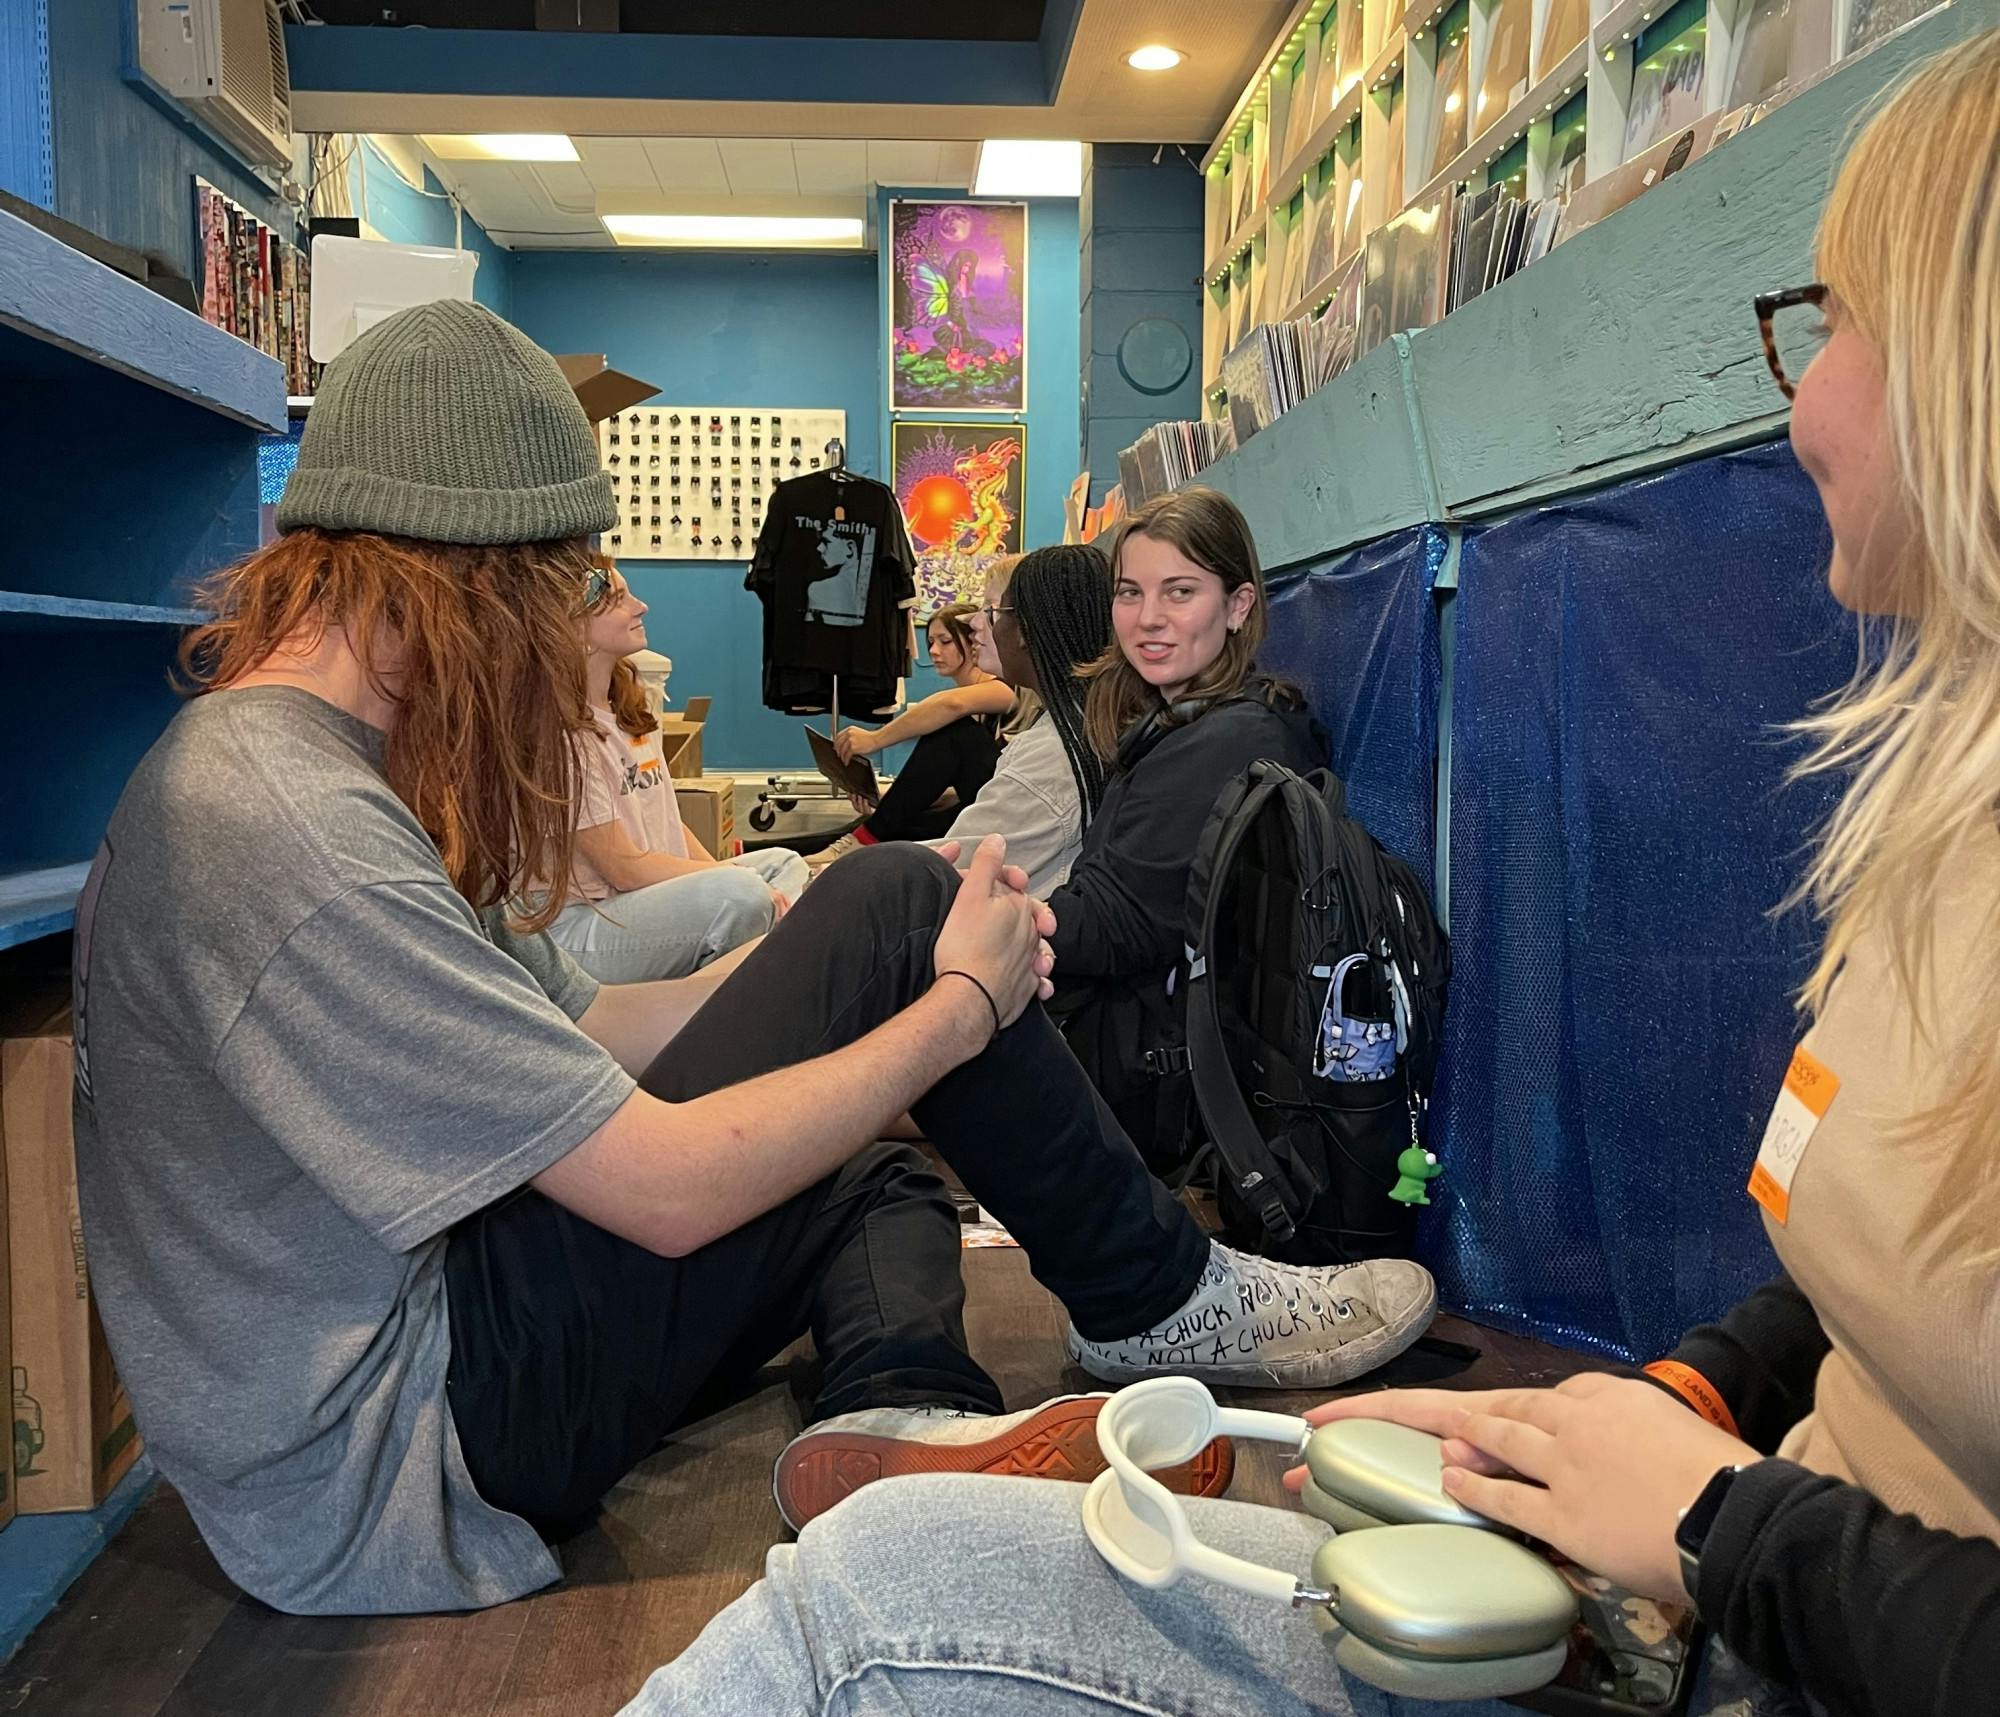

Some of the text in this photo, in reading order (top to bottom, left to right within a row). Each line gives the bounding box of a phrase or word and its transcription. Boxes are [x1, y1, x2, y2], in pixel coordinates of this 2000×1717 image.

[795, 516, 823, 531] The
[1147, 1342, 1202, 1366] NOT
[1210, 1335, 1234, 1365] A
[1238, 1311, 1311, 1353] CHUCK
[1164, 1303, 1233, 1346] CHUCK
[1684, 1379, 1713, 1408] LAND
